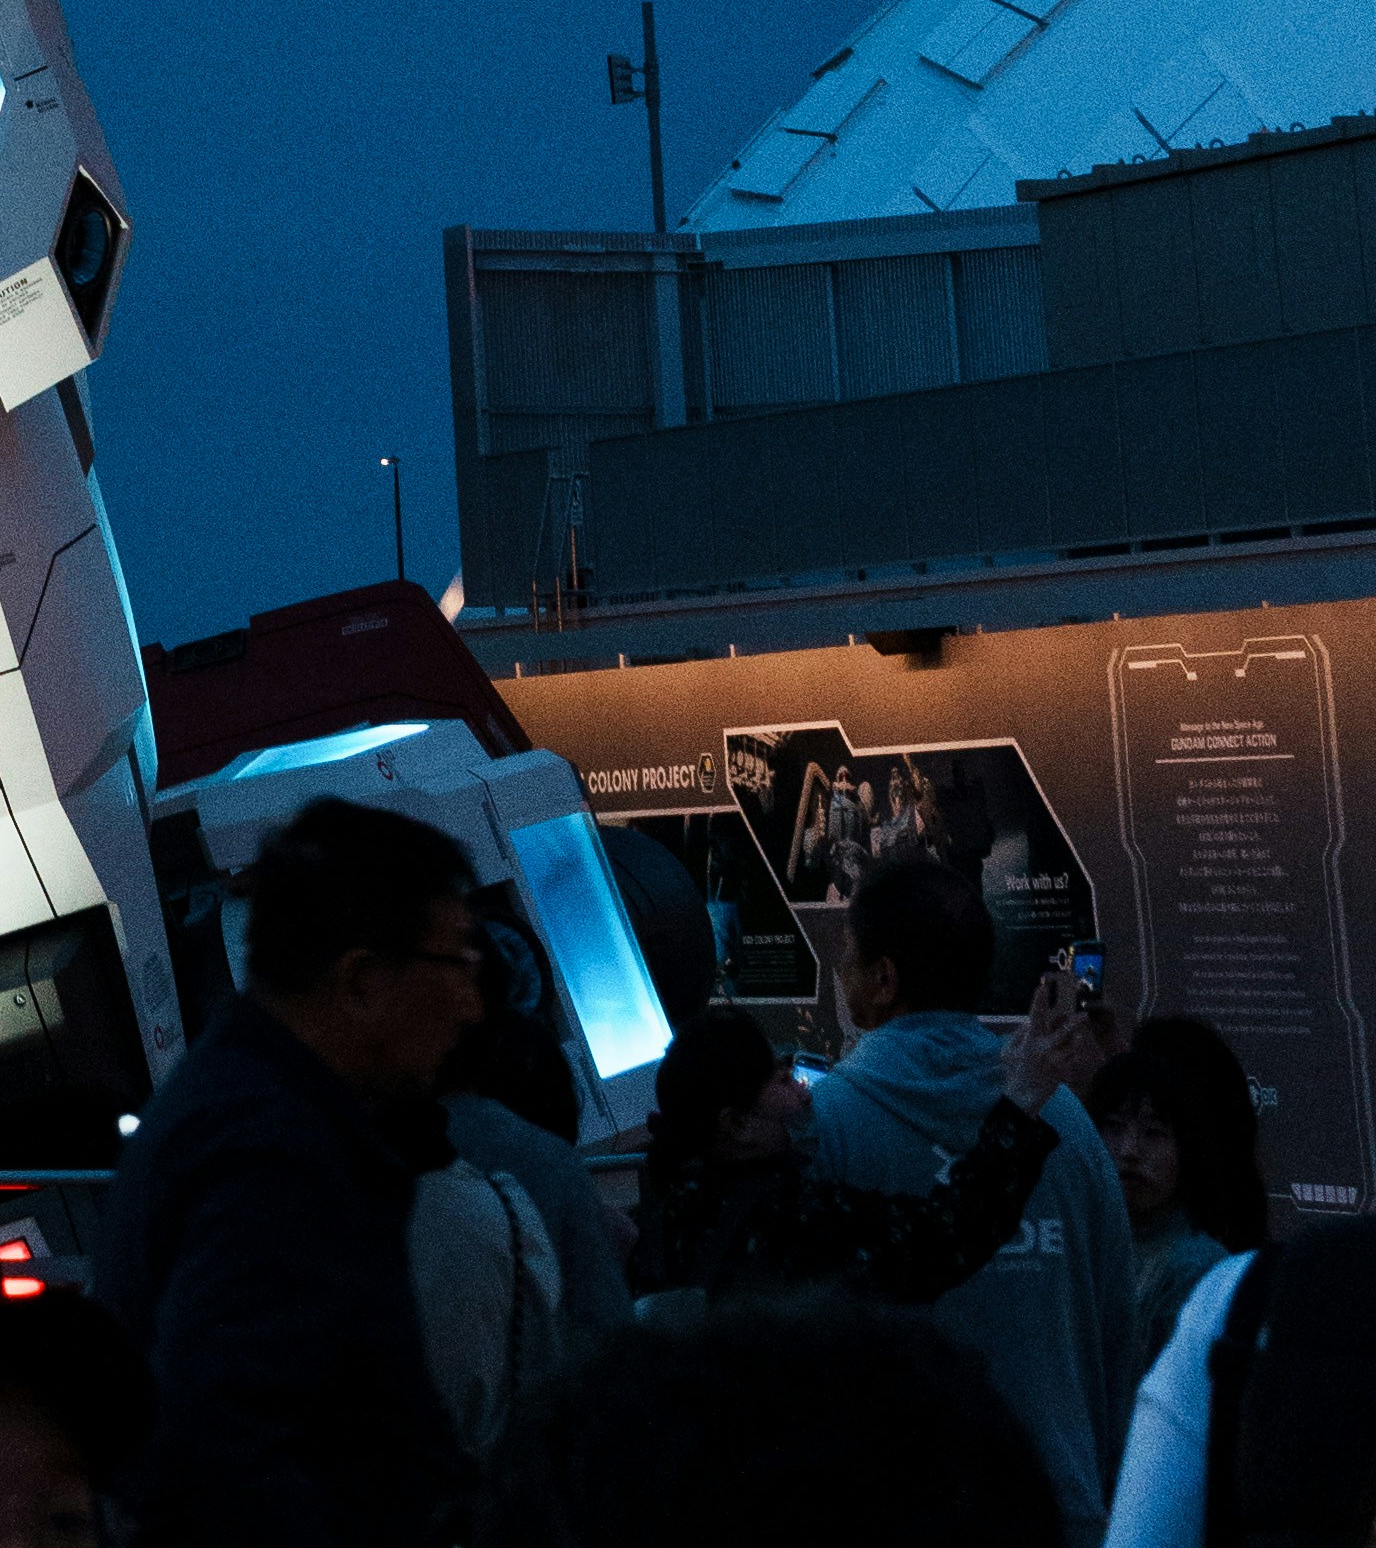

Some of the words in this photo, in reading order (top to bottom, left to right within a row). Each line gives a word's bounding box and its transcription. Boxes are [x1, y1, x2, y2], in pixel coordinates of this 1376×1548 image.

[1170, 737, 1206, 751] GUNDAM
[1206, 735, 1244, 749] CONNECT
[1245, 732, 1278, 748] ACTION
[588, 767, 639, 795] COLONY
[641, 764, 696, 792] PROJECT
[1005, 872, 1031, 891] Work
[1031, 871, 1052, 891] with
[1052, 870, 1069, 890] us?
